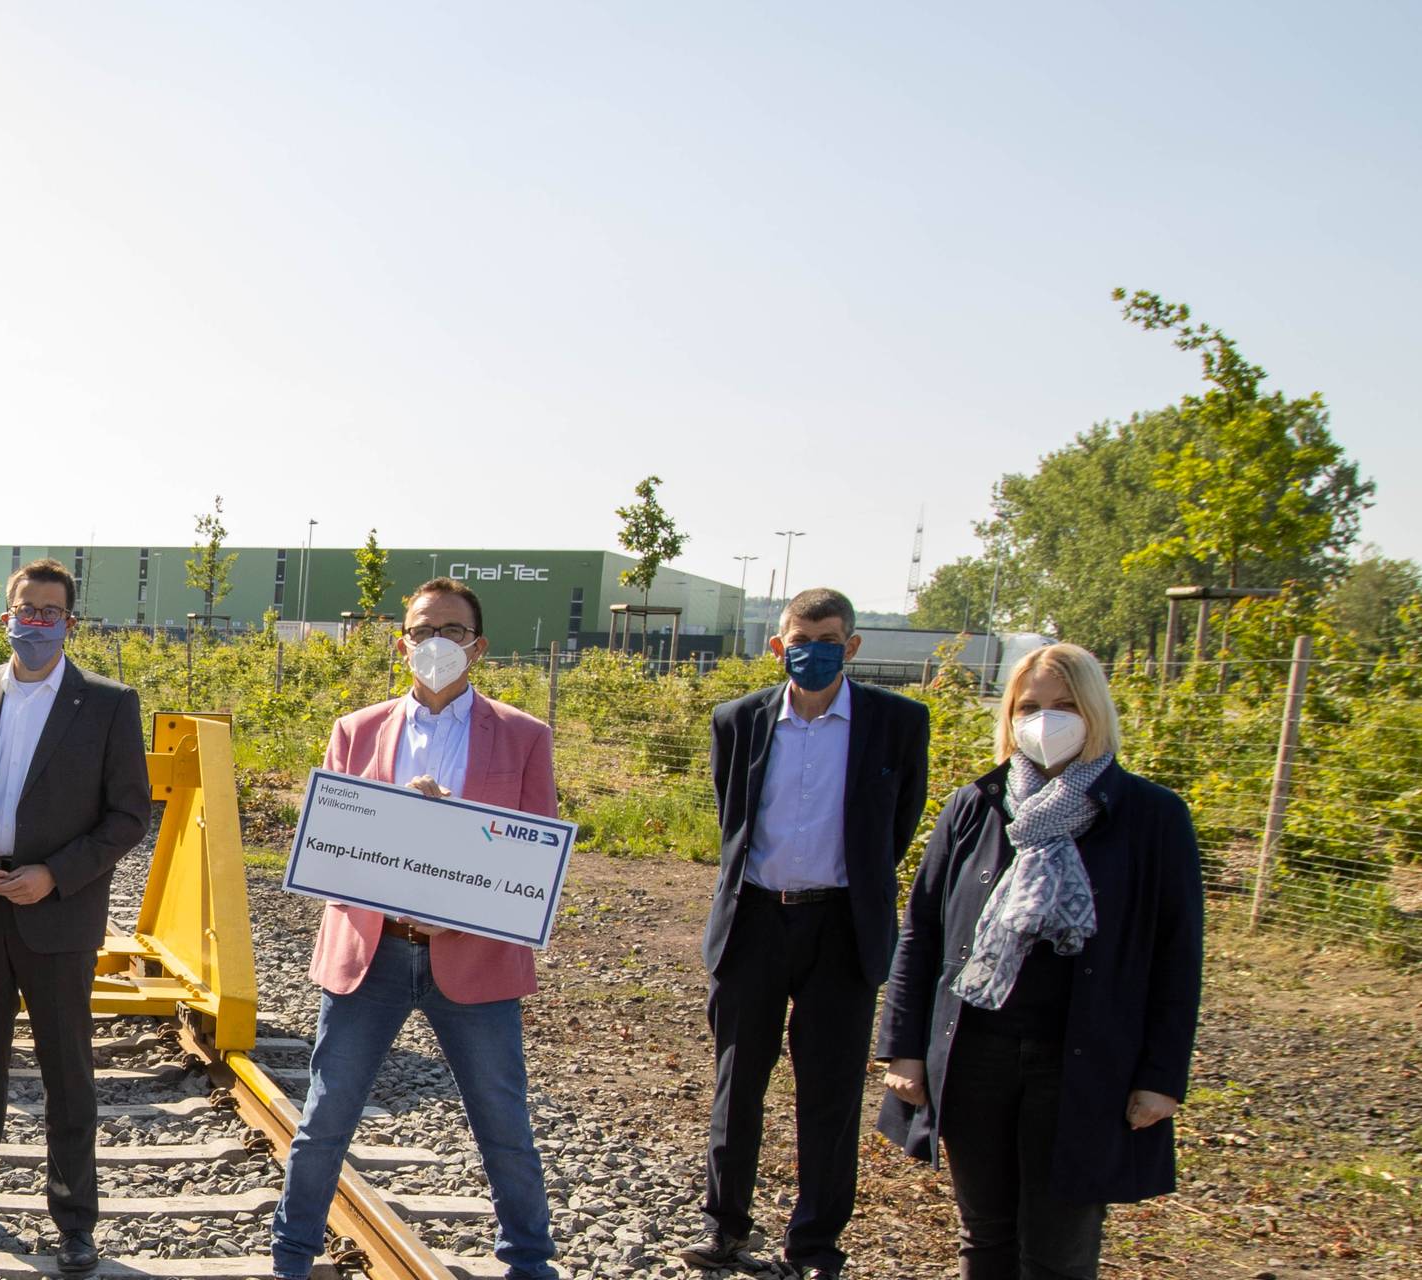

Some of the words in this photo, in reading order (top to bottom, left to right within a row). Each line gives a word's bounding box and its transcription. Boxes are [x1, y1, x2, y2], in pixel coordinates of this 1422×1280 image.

[449, 563, 549, 581] Chal-Tec
[320, 784, 360, 800] Herzlich
[318, 796, 377, 817] Willkommen
[505, 823, 540, 842] NRB
[306, 837, 401, 869] Kamp-Lintfort
[403, 858, 492, 889] Kattenstraße
[493, 879, 503, 892] /
[504, 881, 546, 900] LAGA
